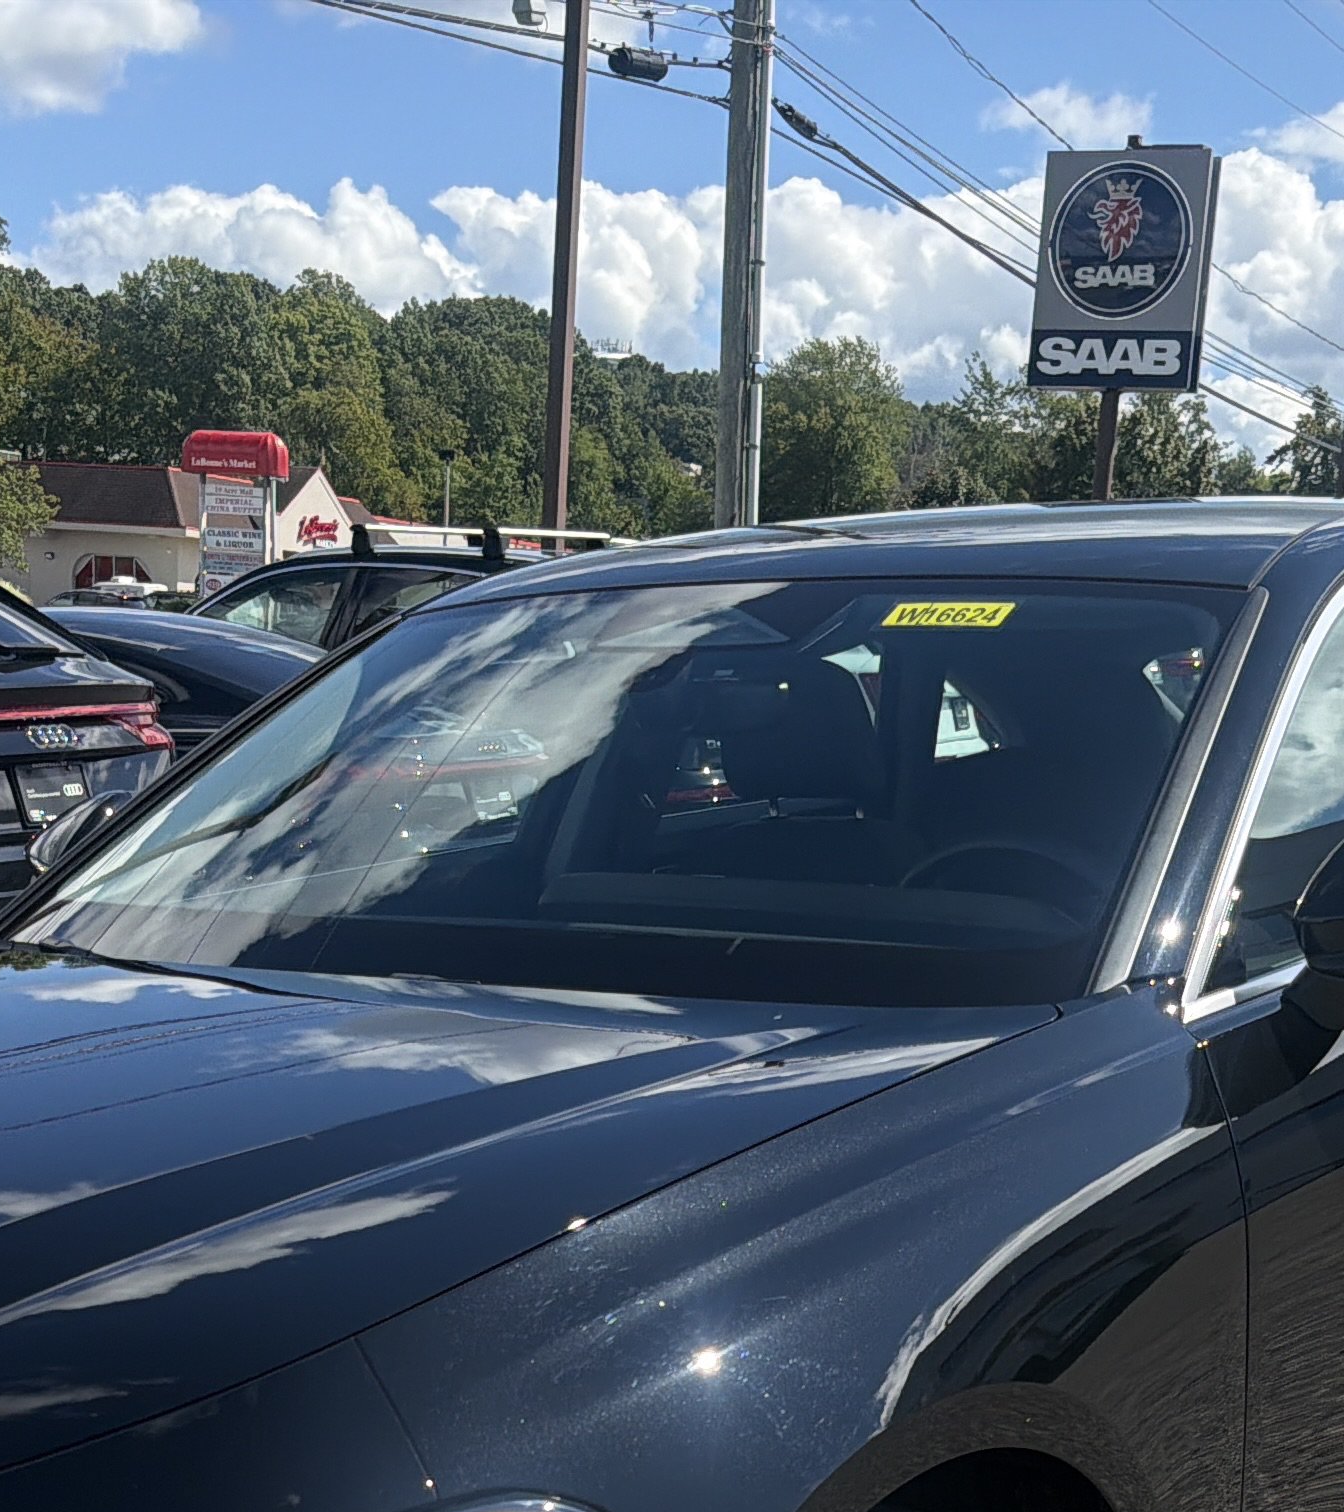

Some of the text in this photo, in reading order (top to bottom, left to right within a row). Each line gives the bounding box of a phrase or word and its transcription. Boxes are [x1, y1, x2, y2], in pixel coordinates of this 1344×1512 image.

[1074, 264, 1155, 289] SAAB
[1036, 336, 1181, 376] SAAB
[191, 457, 256, 469] LaBonne's Market
[215, 498, 254, 506] IMPERIAL
[205, 505, 262, 515] CHINA BUFFET
[207, 529, 262, 540] CLASSIC WINE
[224, 540, 254, 549] LIQUOR
